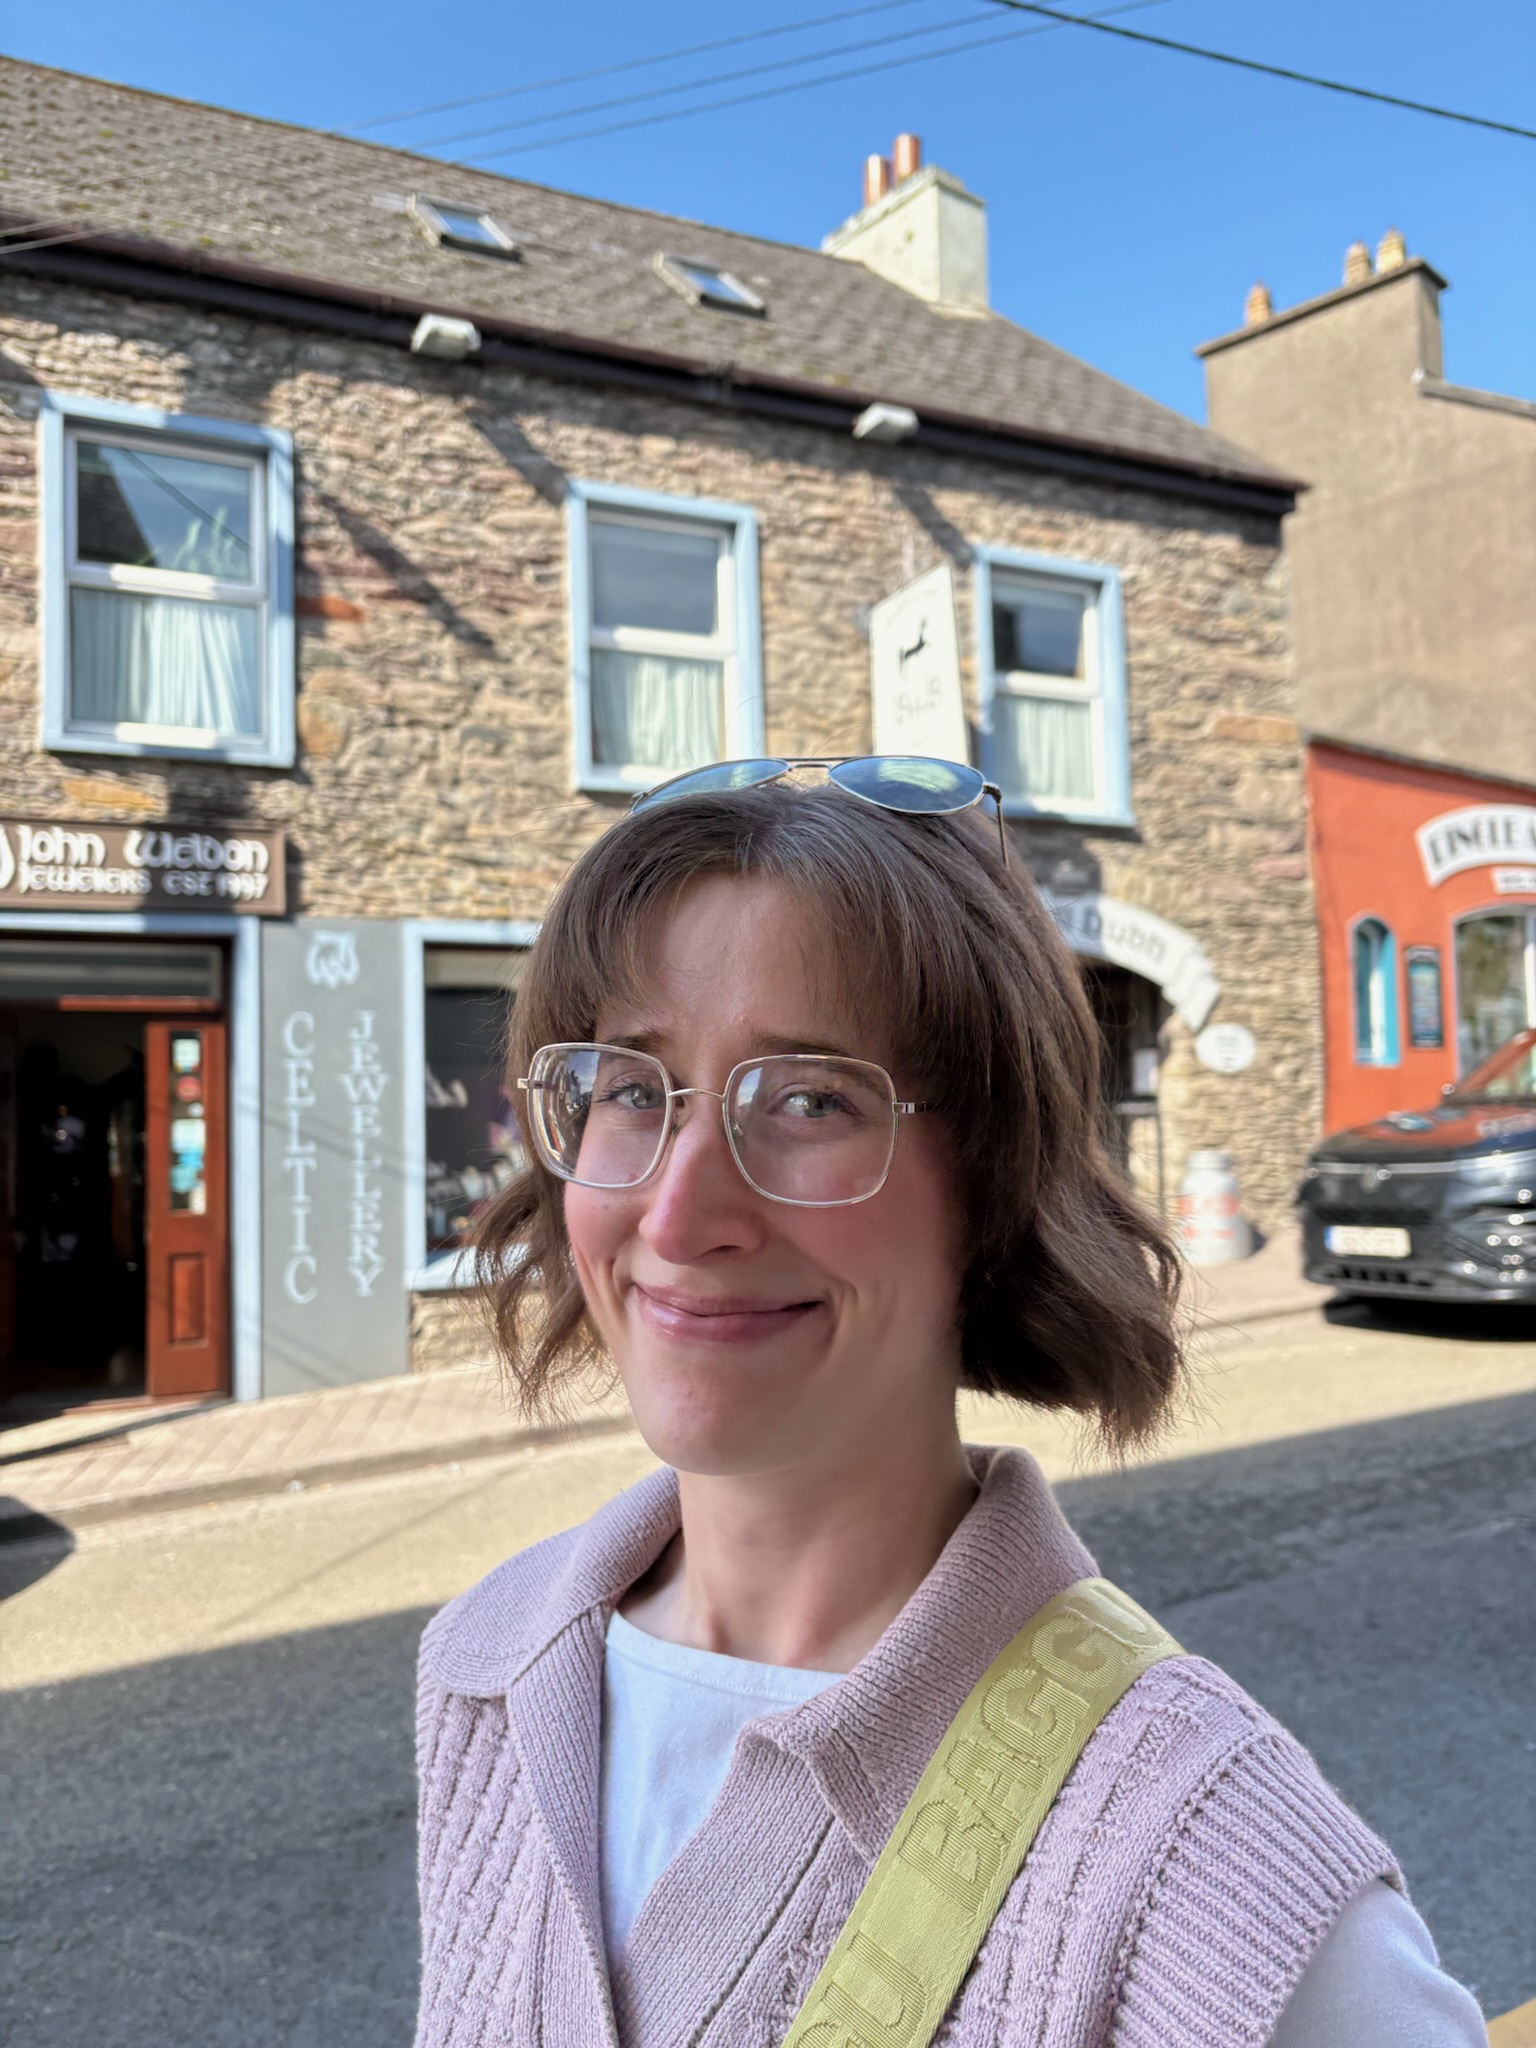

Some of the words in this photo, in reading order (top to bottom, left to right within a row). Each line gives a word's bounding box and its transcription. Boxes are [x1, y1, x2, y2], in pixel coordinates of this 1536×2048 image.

[17, 825, 106, 867] John
[124, 829, 269, 873] Weldon
[282, 1010, 318, 1304] CELTIC
[338, 1010, 389, 1297] JEWELLERY
